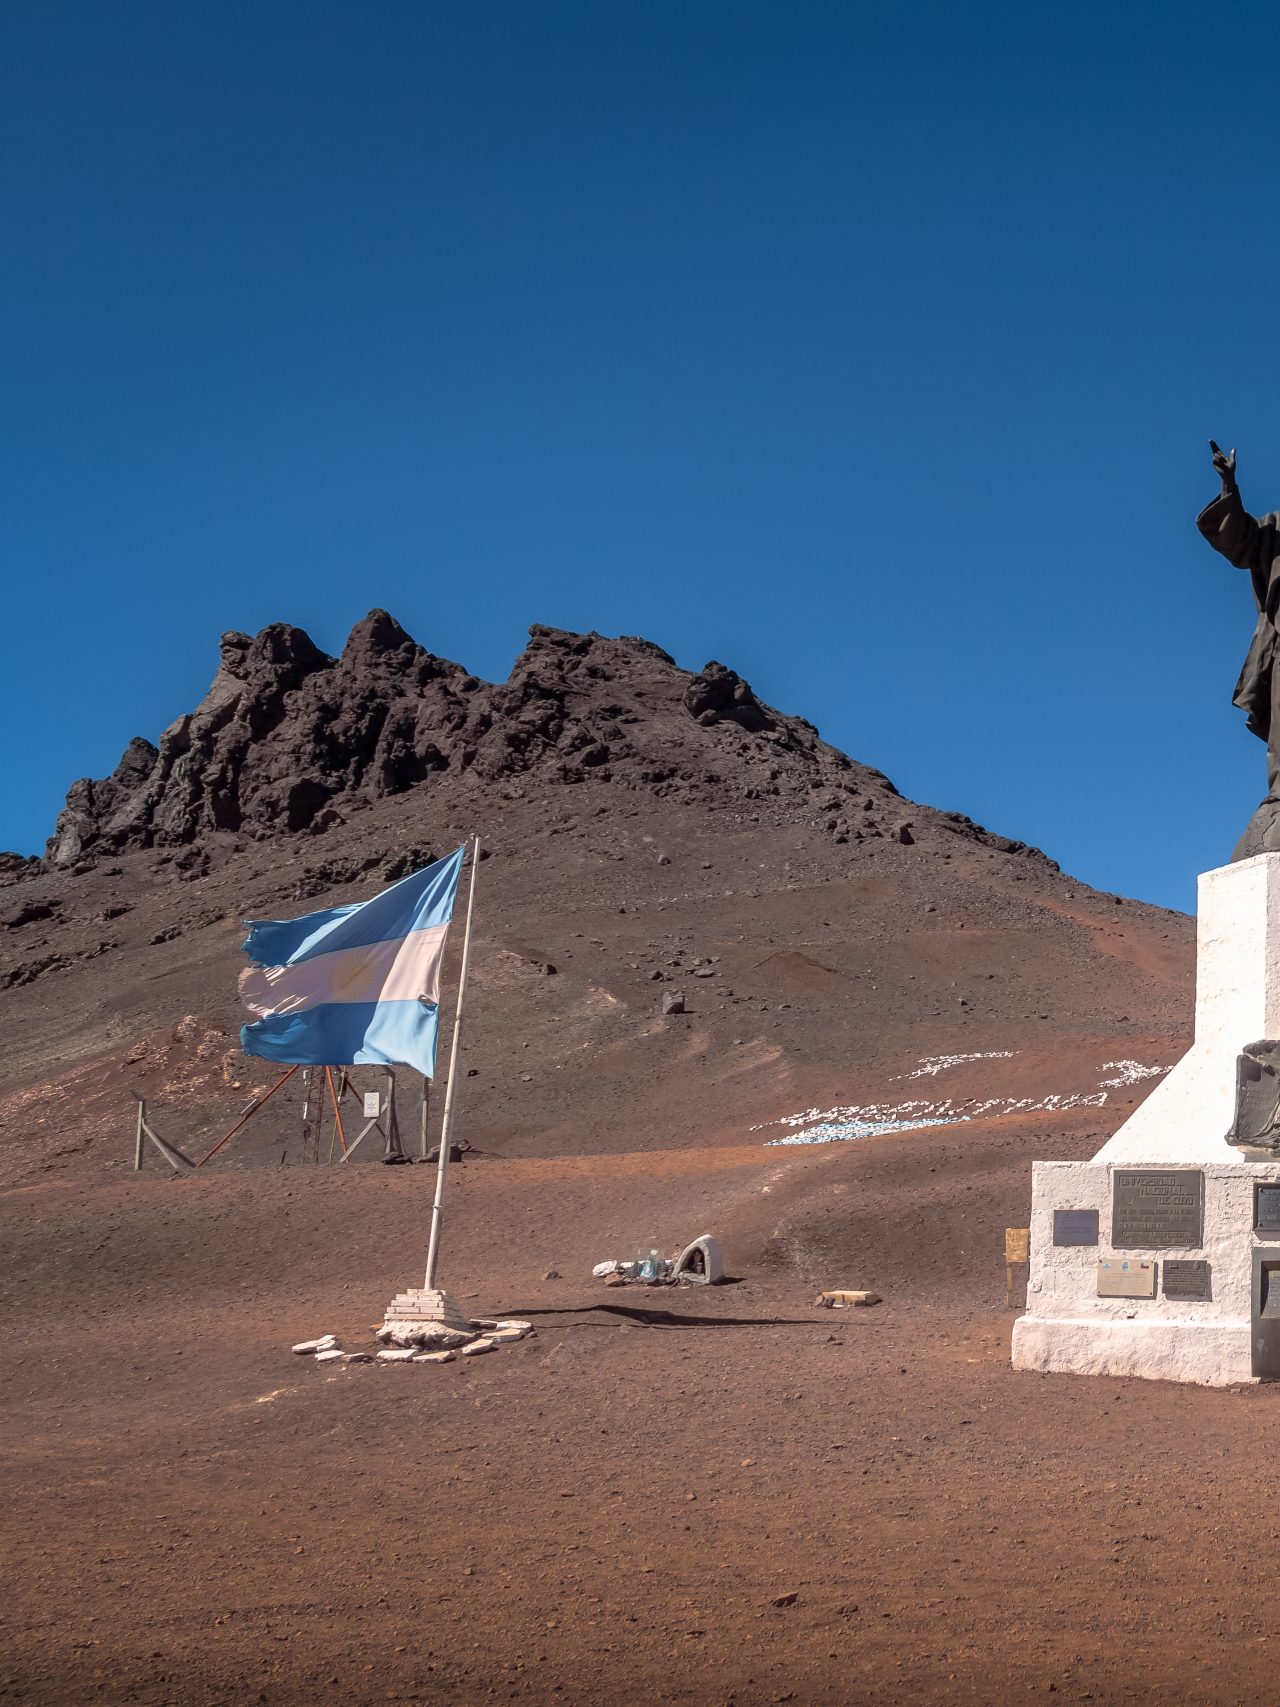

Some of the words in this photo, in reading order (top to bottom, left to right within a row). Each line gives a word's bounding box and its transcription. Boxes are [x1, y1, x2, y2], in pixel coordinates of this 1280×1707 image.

[1120, 1176, 1176, 1187] UNIVERSIDAD
[1140, 1187, 1185, 1196] NACIONAL
[1159, 1196, 1171, 1206] DE
[1174, 1196, 1194, 1206] CUYO
